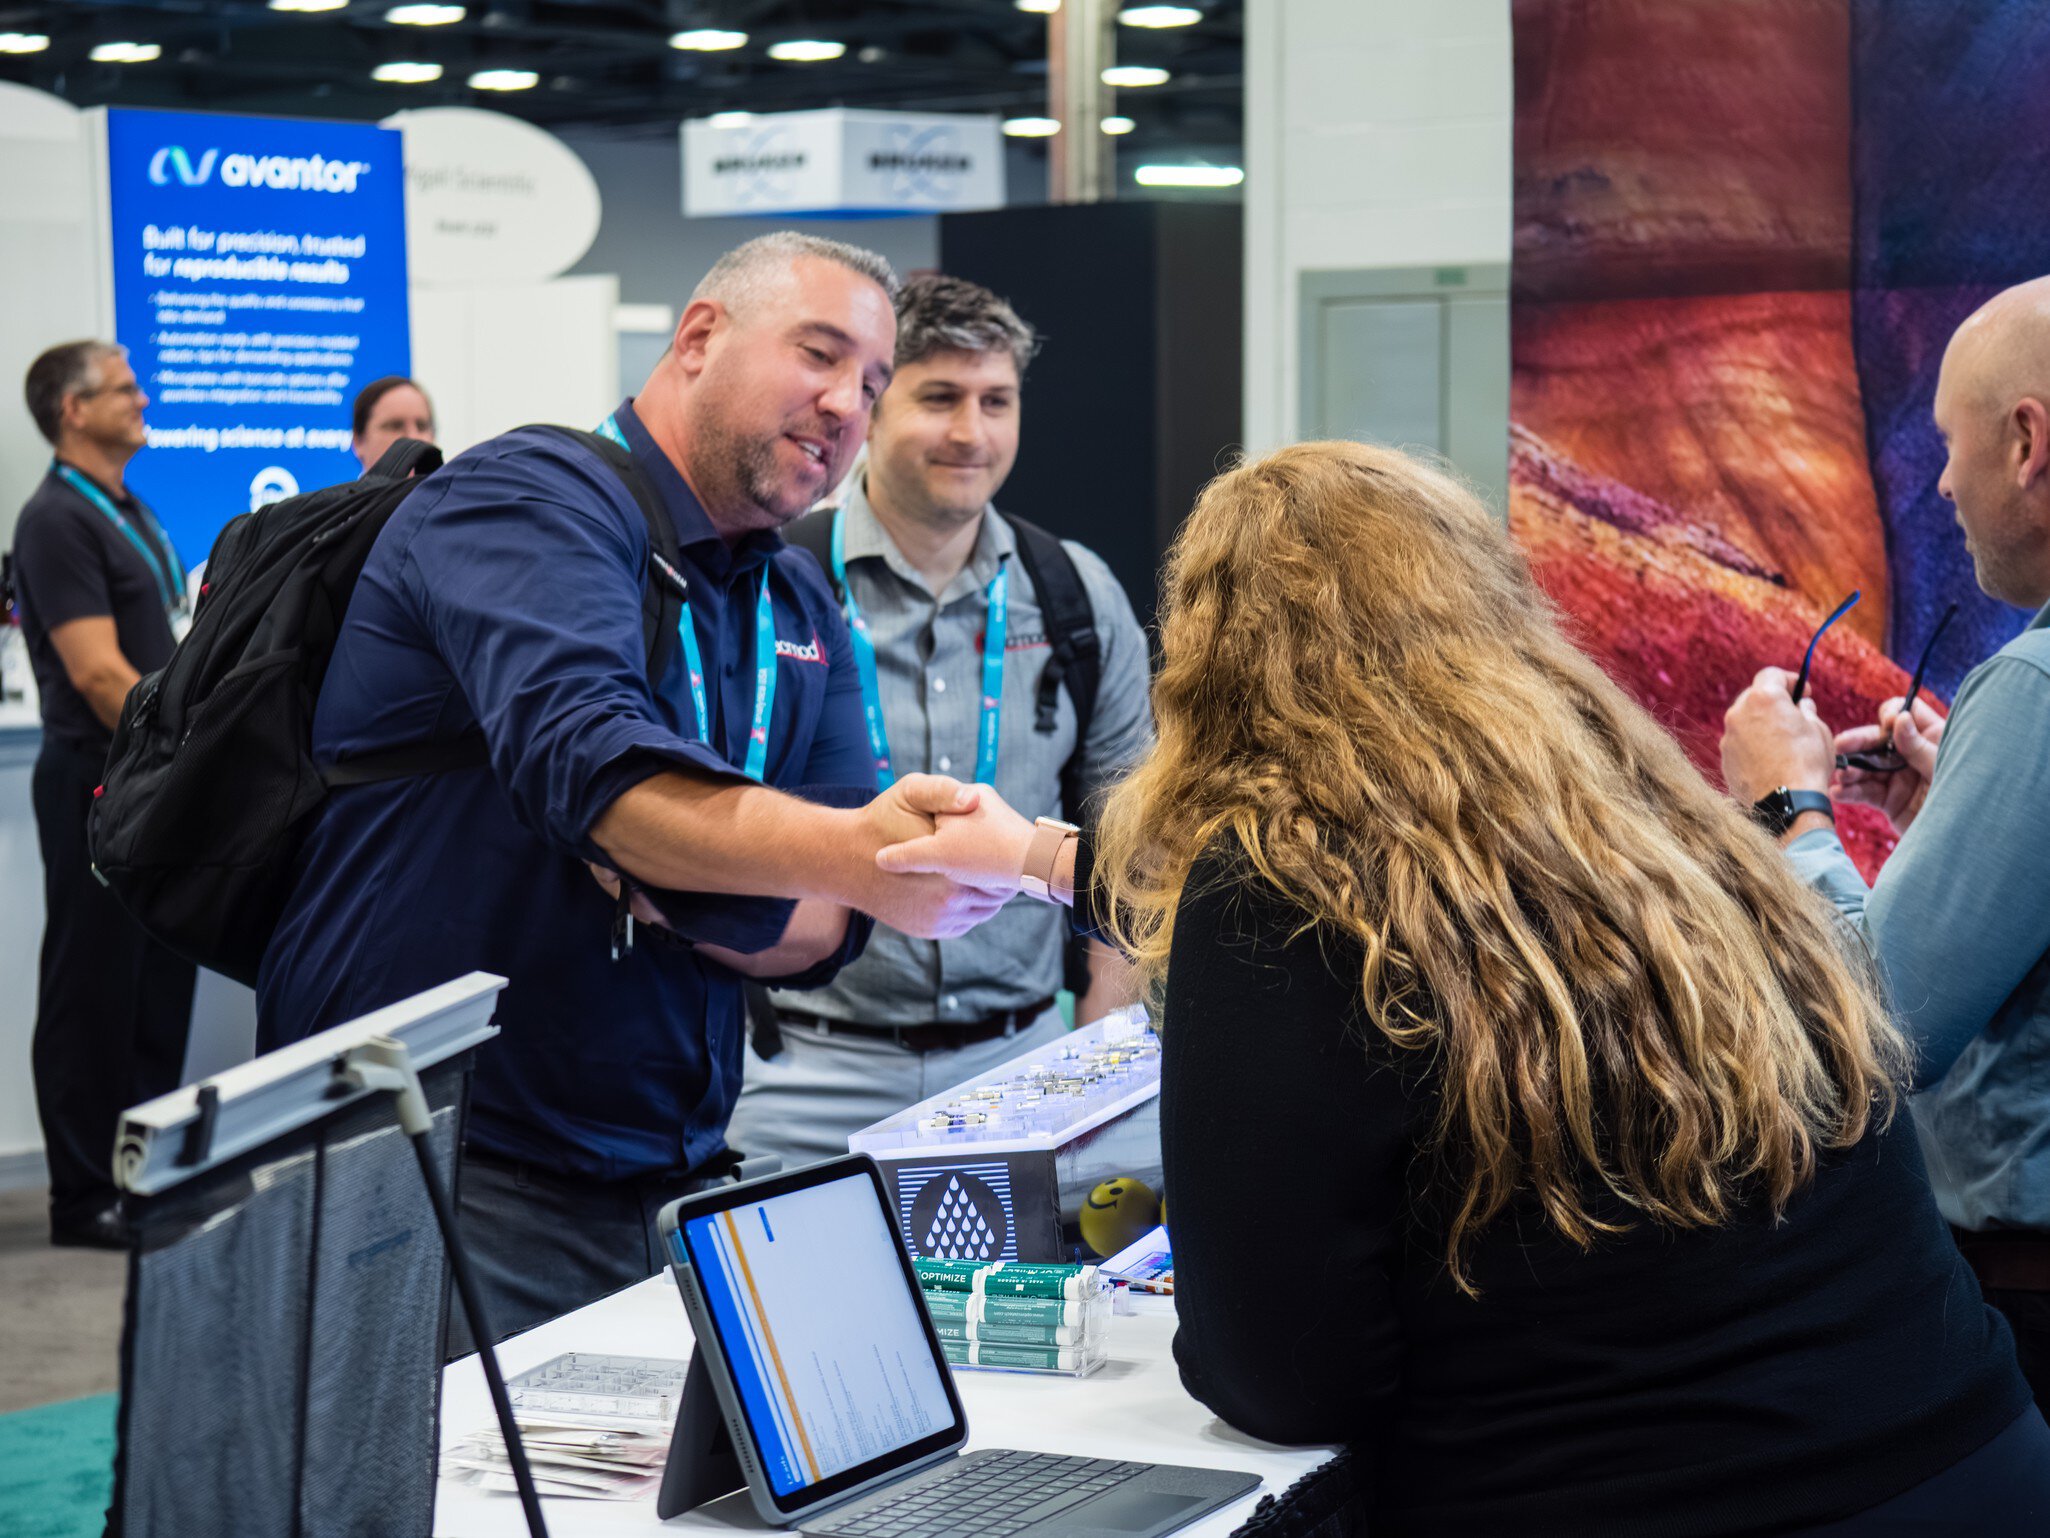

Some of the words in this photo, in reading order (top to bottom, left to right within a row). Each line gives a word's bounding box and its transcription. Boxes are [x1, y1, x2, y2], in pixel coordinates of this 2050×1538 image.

[220, 154, 360, 193] avantor
[142, 224, 185, 250] Built
[187, 225, 215, 251] for
[301, 233, 366, 258] trusted
[144, 251, 172, 276] for
[173, 254, 288, 282] reproducible
[289, 258, 350, 284] results
[143, 424, 219, 453] owering
[219, 423, 284, 449] science
[284, 426, 305, 449] at
[921, 1271, 966, 1284] OPTIMIZE
